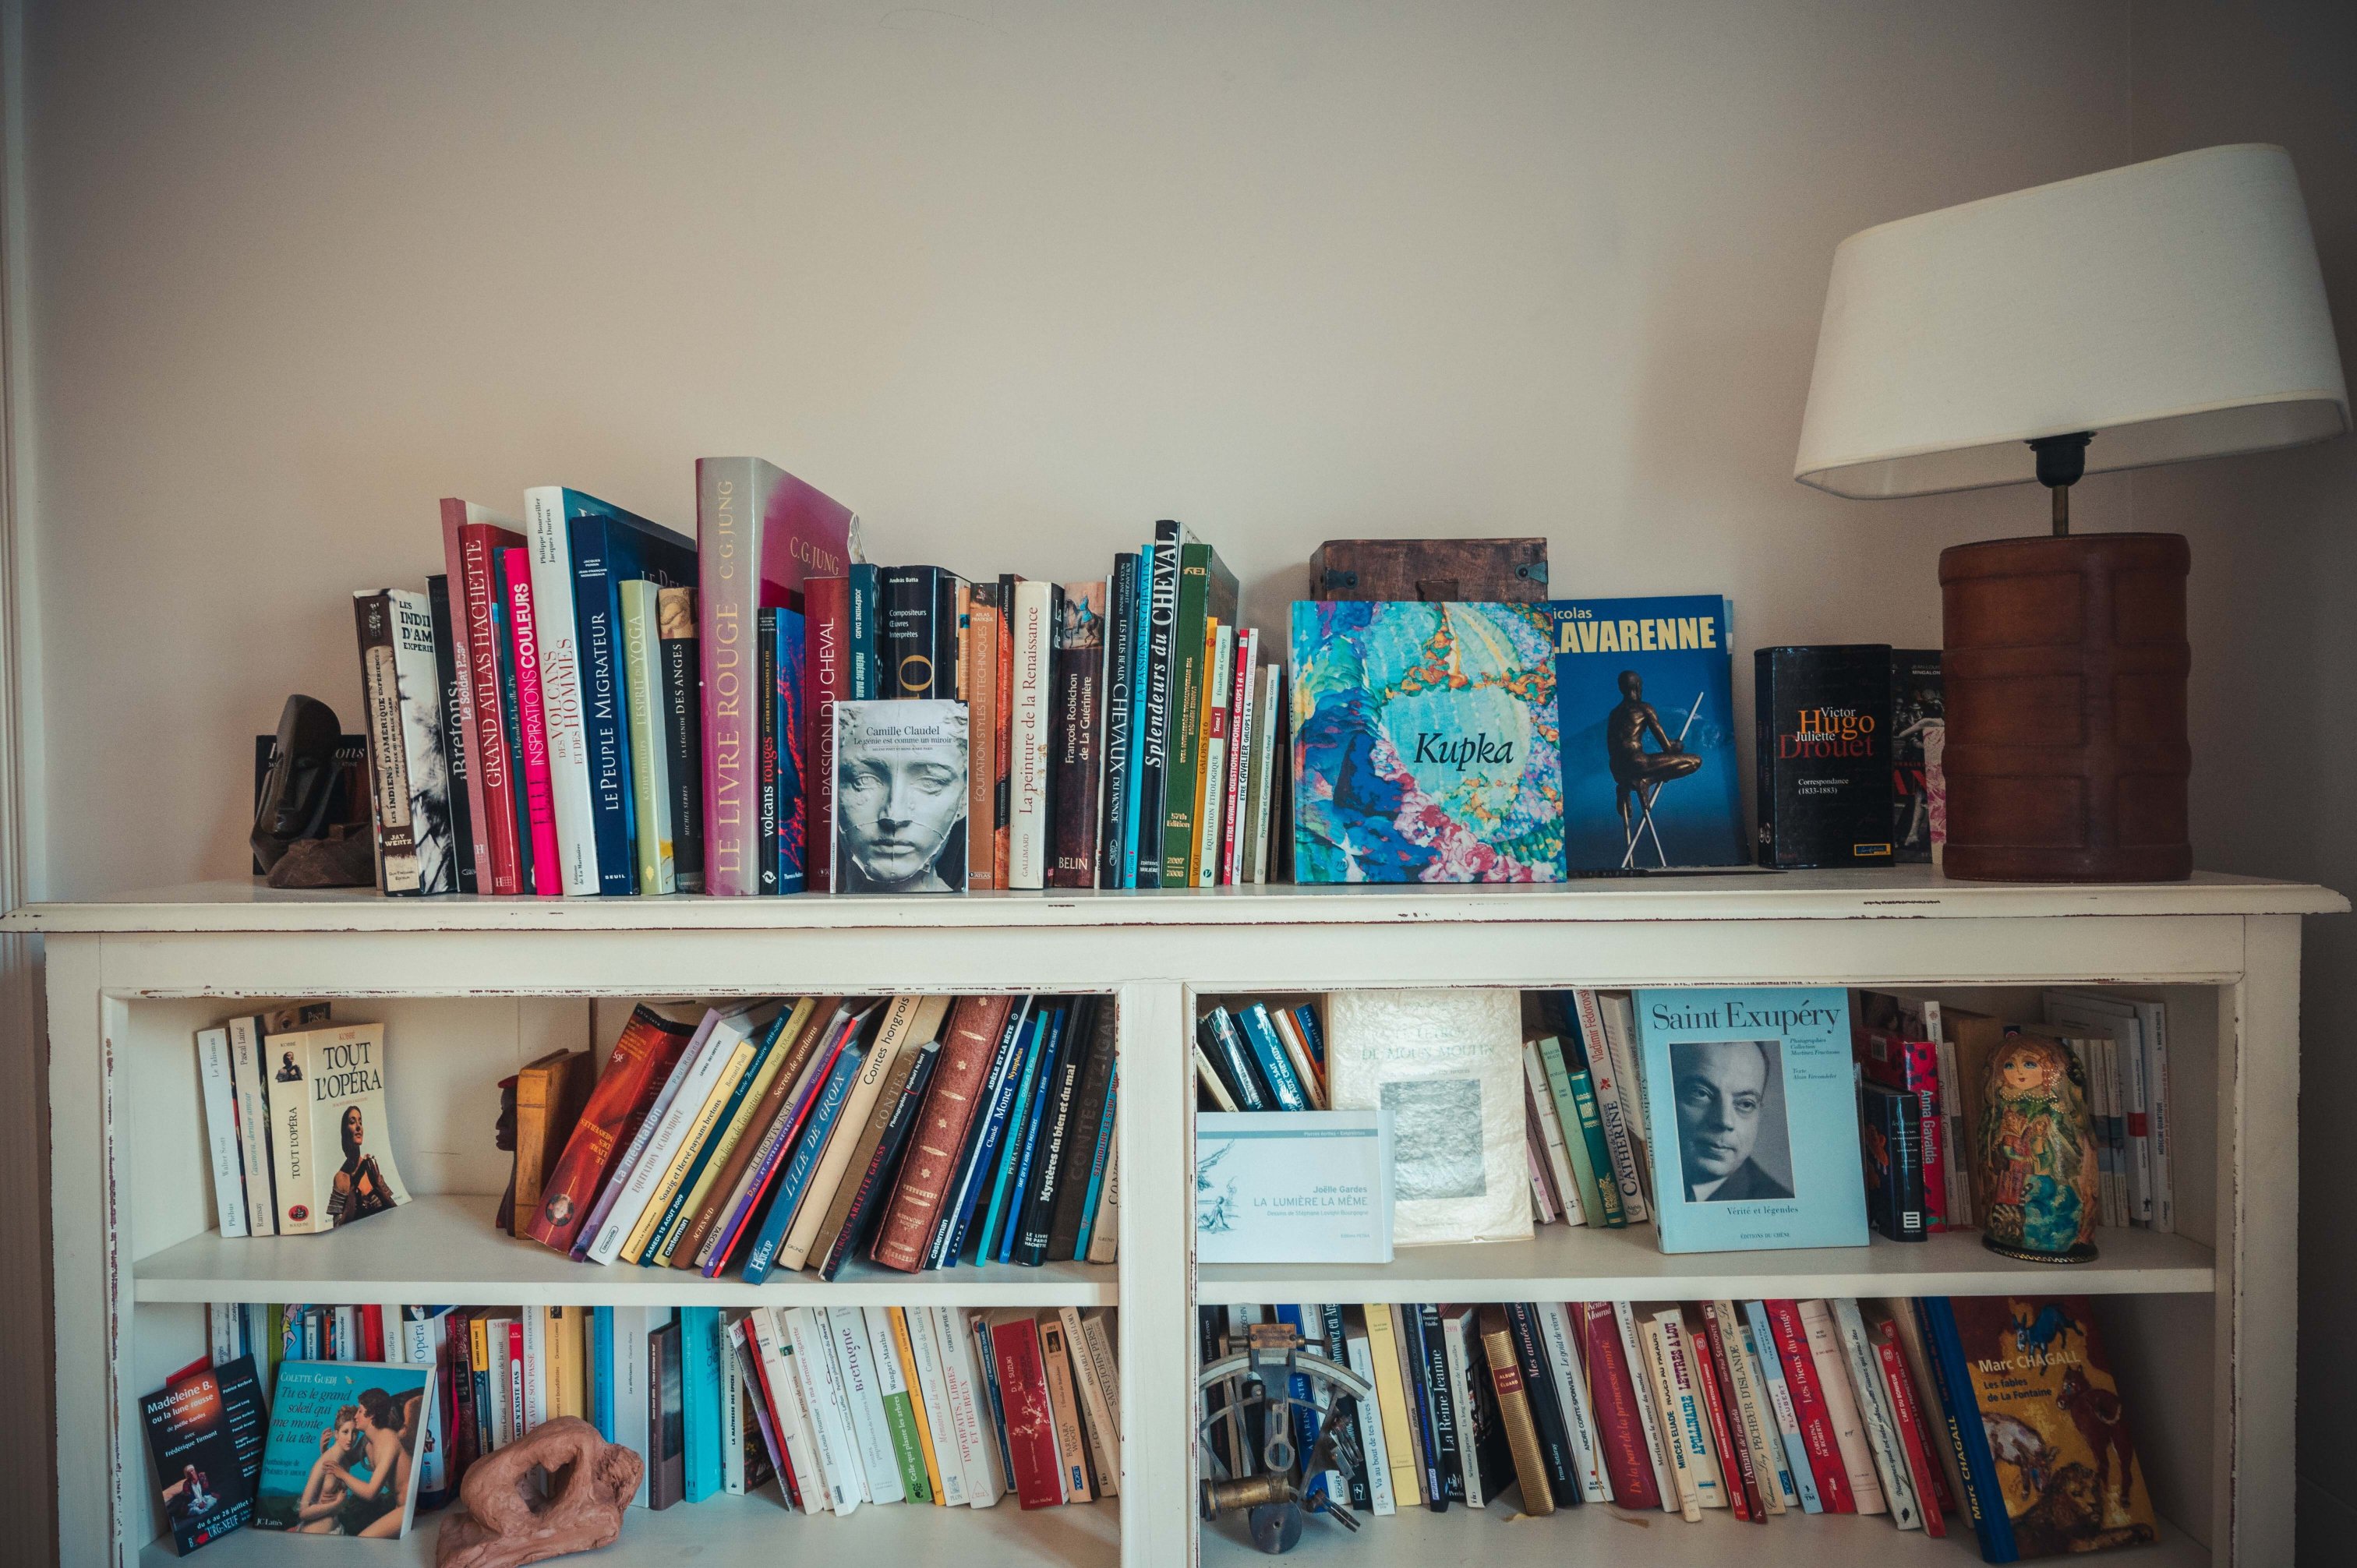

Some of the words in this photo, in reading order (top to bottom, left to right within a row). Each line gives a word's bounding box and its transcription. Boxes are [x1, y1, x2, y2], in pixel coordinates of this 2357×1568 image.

[811, 546, 839, 575] JUNG
[466, 540, 489, 647] HACHETTE
[1152, 532, 1176, 626] CHEVAL
[514, 584, 535, 669] COULEURS
[1553, 607, 1592, 620] icolas
[889, 630, 918, 639] Interprètes
[1023, 606, 1038, 690] Renaissance
[1151, 634, 1167, 657] du
[1554, 616, 1716, 654] AVARENNE
[592, 612, 613, 719] MIGRATEUR
[716, 602, 740, 718] ROUGE
[475, 654, 497, 712] ATLAS
[1067, 673, 1077, 720] Robichon
[1022, 695, 1035, 707] la
[1080, 676, 1091, 729] Guérinière
[1145, 662, 1166, 768] Splendeurs
[1820, 708, 1856, 718] Victor
[380, 697, 390, 763] D'AMÉRIQUE
[521, 670, 545, 766] INSPIRATIONS
[866, 726, 902, 736] Camille
[904, 726, 940, 736] Claudel
[1022, 712, 1035, 729] de
[1798, 710, 1875, 740] Hugo
[1065, 723, 1077, 764] François
[1080, 732, 1089, 744] La
[1779, 735, 1874, 758] Drouet
[1795, 731, 1836, 742] Juliette
[482, 719, 502, 787] GRAND
[600, 728, 617, 789] PEUPLE
[764, 736, 777, 782] rouges
[1020, 733, 1037, 792] peinture
[1080, 747, 1089, 761] de
[1267, 751, 1270, 761] du
[1414, 733, 1514, 772] Kupka
[387, 765, 397, 807] INDIENS
[717, 731, 740, 824] LIVRE
[605, 793, 618, 810] LE
[761, 786, 773, 838] volcans
[1019, 797, 1033, 814] La
[385, 838, 412, 846] WERTZ
[719, 839, 740, 873] LE
[1058, 857, 1088, 870] BELIN
[1652, 1003, 1720, 1030] Saint
[1725, 999, 1841, 1036] Exupéry
[323, 1042, 372, 1070] TOUT
[864, 1047, 888, 1086] Contes
[883, 997, 910, 1049] hongrois
[315, 1065, 383, 1101] L'OPÉRA
[1067, 1064, 1076, 1086] mal
[986, 1125, 998, 1148] Claude
[994, 1086, 1012, 1120] Monet
[1008, 1047, 1023, 1080] Nymphéas
[1061, 1085, 1072, 1100] du
[1921, 1089, 1933, 1118] Anna
[612, 1170, 627, 1184] La
[624, 1107, 663, 1167] méditation
[672, 1066, 684, 1083] Paul
[684, 1040, 700, 1067] Roland
[1054, 1111, 1066, 1134] bien
[289, 1107, 299, 1150] L'OPÉRA
[1051, 1133, 1062, 1151] du
[1921, 1118, 1938, 1165] Gavalda
[659, 1180, 677, 1202] Soazig
[676, 1148, 692, 1168] Hervé
[689, 1128, 708, 1153] paysans
[705, 1099, 722, 1126] bretons
[1612, 1100, 1638, 1197] CATHERINE
[292, 1153, 301, 1179] TOUT
[1041, 1150, 1058, 1202] Mystères
[1253, 1198, 1267, 1206] LA
[1273, 1195, 1318, 1206] LUMIÈRE
[1321, 1197, 1336, 1206] LA
[1338, 1194, 1368, 1206] MÊME
[1313, 1185, 1337, 1194] Joëlle
[1339, 1185, 1367, 1194] Gardes
[826, 1253, 838, 1271] LE
[835, 1222, 852, 1252] CIRQUE
[850, 1178, 871, 1220] ARLETTE
[869, 1145, 886, 1176] GRUSS
[1726, 1207, 1751, 1216] Vérité
[1764, 1206, 1798, 1216] légendes
[645, 1235, 662, 1259] SAMEDI
[664, 1210, 677, 1227] AOUT
[673, 1194, 684, 1210] 2009
[665, 1219, 688, 1256] casterman
[694, 1225, 709, 1241] ACTES
[705, 1207, 714, 1222] SUD
[931, 1219, 948, 1259] casterman
[702, 1226, 722, 1255] TASCHEN
[1665, 1323, 1679, 1337] LOU
[1780, 1310, 1794, 1340] tango
[842, 1327, 864, 1392] Bretagne
[879, 1331, 890, 1359] Maathai
[1788, 1337, 1798, 1353] du
[885, 1361, 896, 1390] Wangari
[1431, 1349, 1447, 1393] Jeanne
[1670, 1350, 1691, 1391] LETTRES
[1793, 1355, 1808, 1386] Dieux
[1979, 1358, 2015, 1374] Marc
[2016, 1350, 2080, 1369] CHAGALL
[280, 1372, 312, 1383] COLETTE
[314, 1373, 337, 1385] GUEDJ
[1984, 1379, 1998, 1390] Les
[2001, 1377, 2028, 1389] fables
[147, 1386, 200, 1414] Madeleine
[203, 1381, 213, 1390] B.
[152, 1415, 162, 1425] ou
[164, 1411, 171, 1419] la
[172, 1404, 189, 1416] lune
[190, 1393, 214, 1408] rousse
[281, 1386, 295, 1397] Tu
[310, 1388, 318, 1399] le
[320, 1389, 352, 1402] grand
[288, 1402, 312, 1414] soleil
[314, 1404, 330, 1415] qui
[894, 1397, 904, 1417] arbres
[1799, 1385, 1812, 1404] Les
[1987, 1392, 1998, 1403] de
[2001, 1390, 2012, 1401] La
[2014, 1386, 2052, 1400] Fontaine
[273, 1418, 289, 1427] me
[292, 1418, 323, 1429] monte
[1437, 1393, 1452, 1432] Reine
[1666, 1411, 1679, 1438] ELIADE
[1681, 1395, 1706, 1455] APOLLINAIRE
[165, 1441, 195, 1457] Frédérique
[196, 1430, 217, 1443] Tirmont
[276, 1432, 281, 1443] à
[284, 1432, 294, 1443] la
[295, 1432, 316, 1443] tête
[901, 1430, 912, 1452] plante
[1443, 1436, 1455, 1452] La
[1949, 1416, 1974, 1481] CHAGALL
[906, 1453, 915, 1464] qui
[1673, 1437, 1686, 1469] MIRCEA
[907, 1464, 917, 1481] Celle
[1969, 1485, 1981, 1520] Marc
